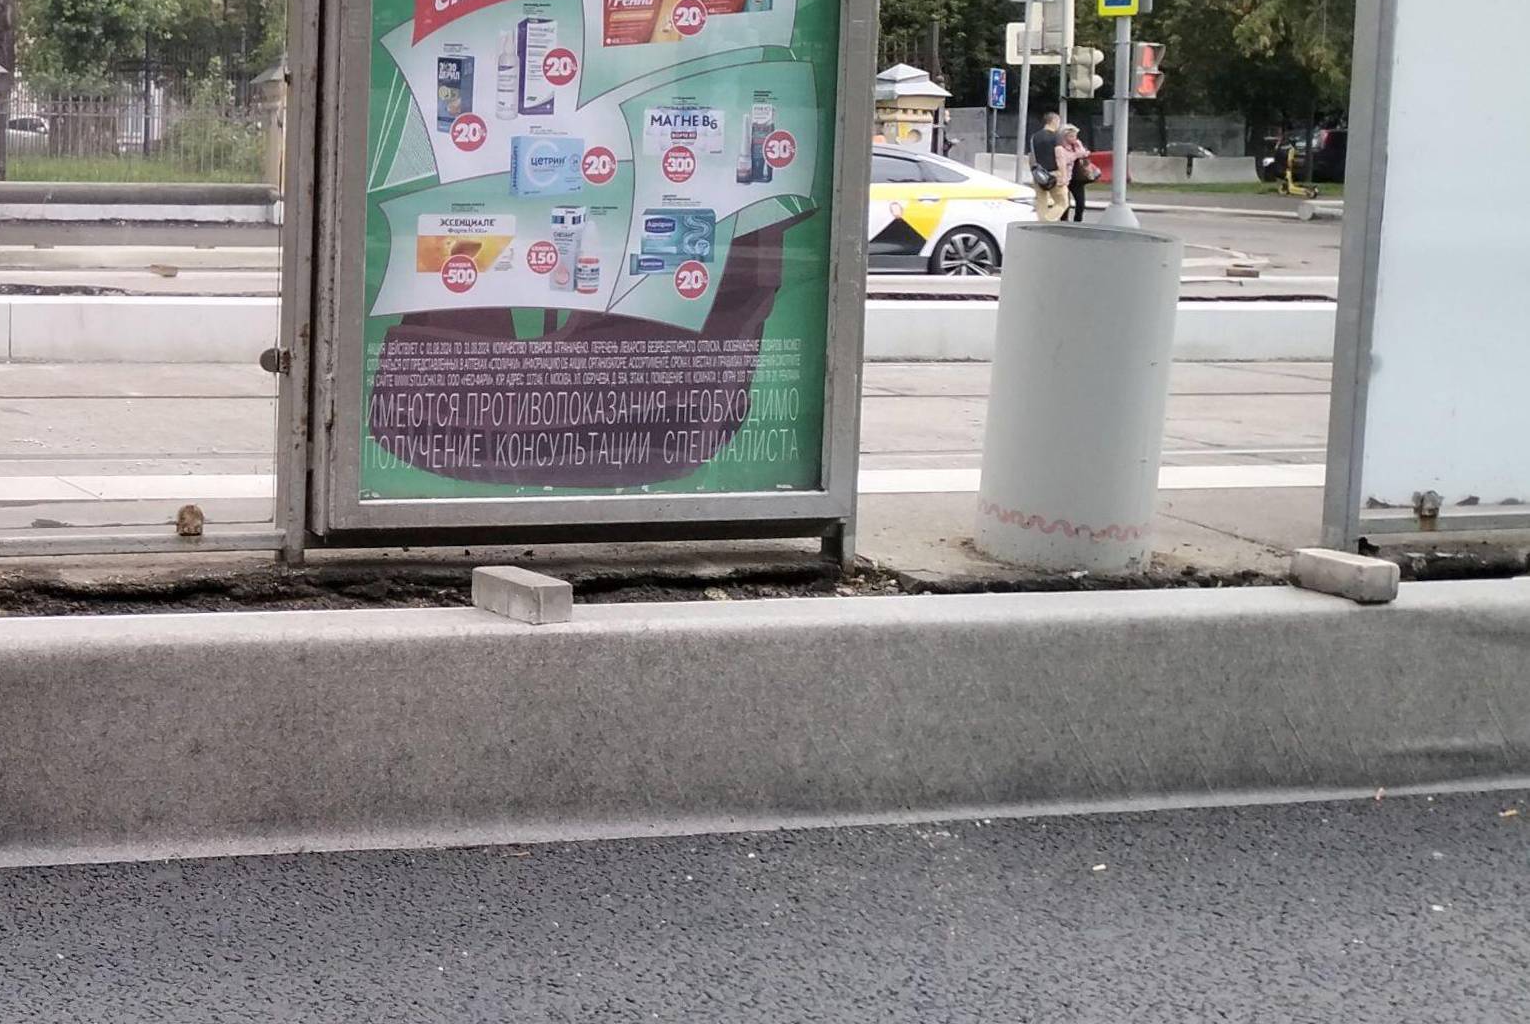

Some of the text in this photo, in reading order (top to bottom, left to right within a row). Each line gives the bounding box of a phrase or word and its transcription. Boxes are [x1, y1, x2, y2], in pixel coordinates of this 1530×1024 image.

[650, 114, 699, 127] МАГНЕ
[365, 387, 799, 427] ИМЕЮТСЯ ПРОТИВОПОКАЗАНИЯ. НЕОБХОДИМО
[365, 429, 800, 469] ПОЛУЧЕНИЕ КОНСУЛЬТАЦИИ СПЕЦИАЛИСТА
